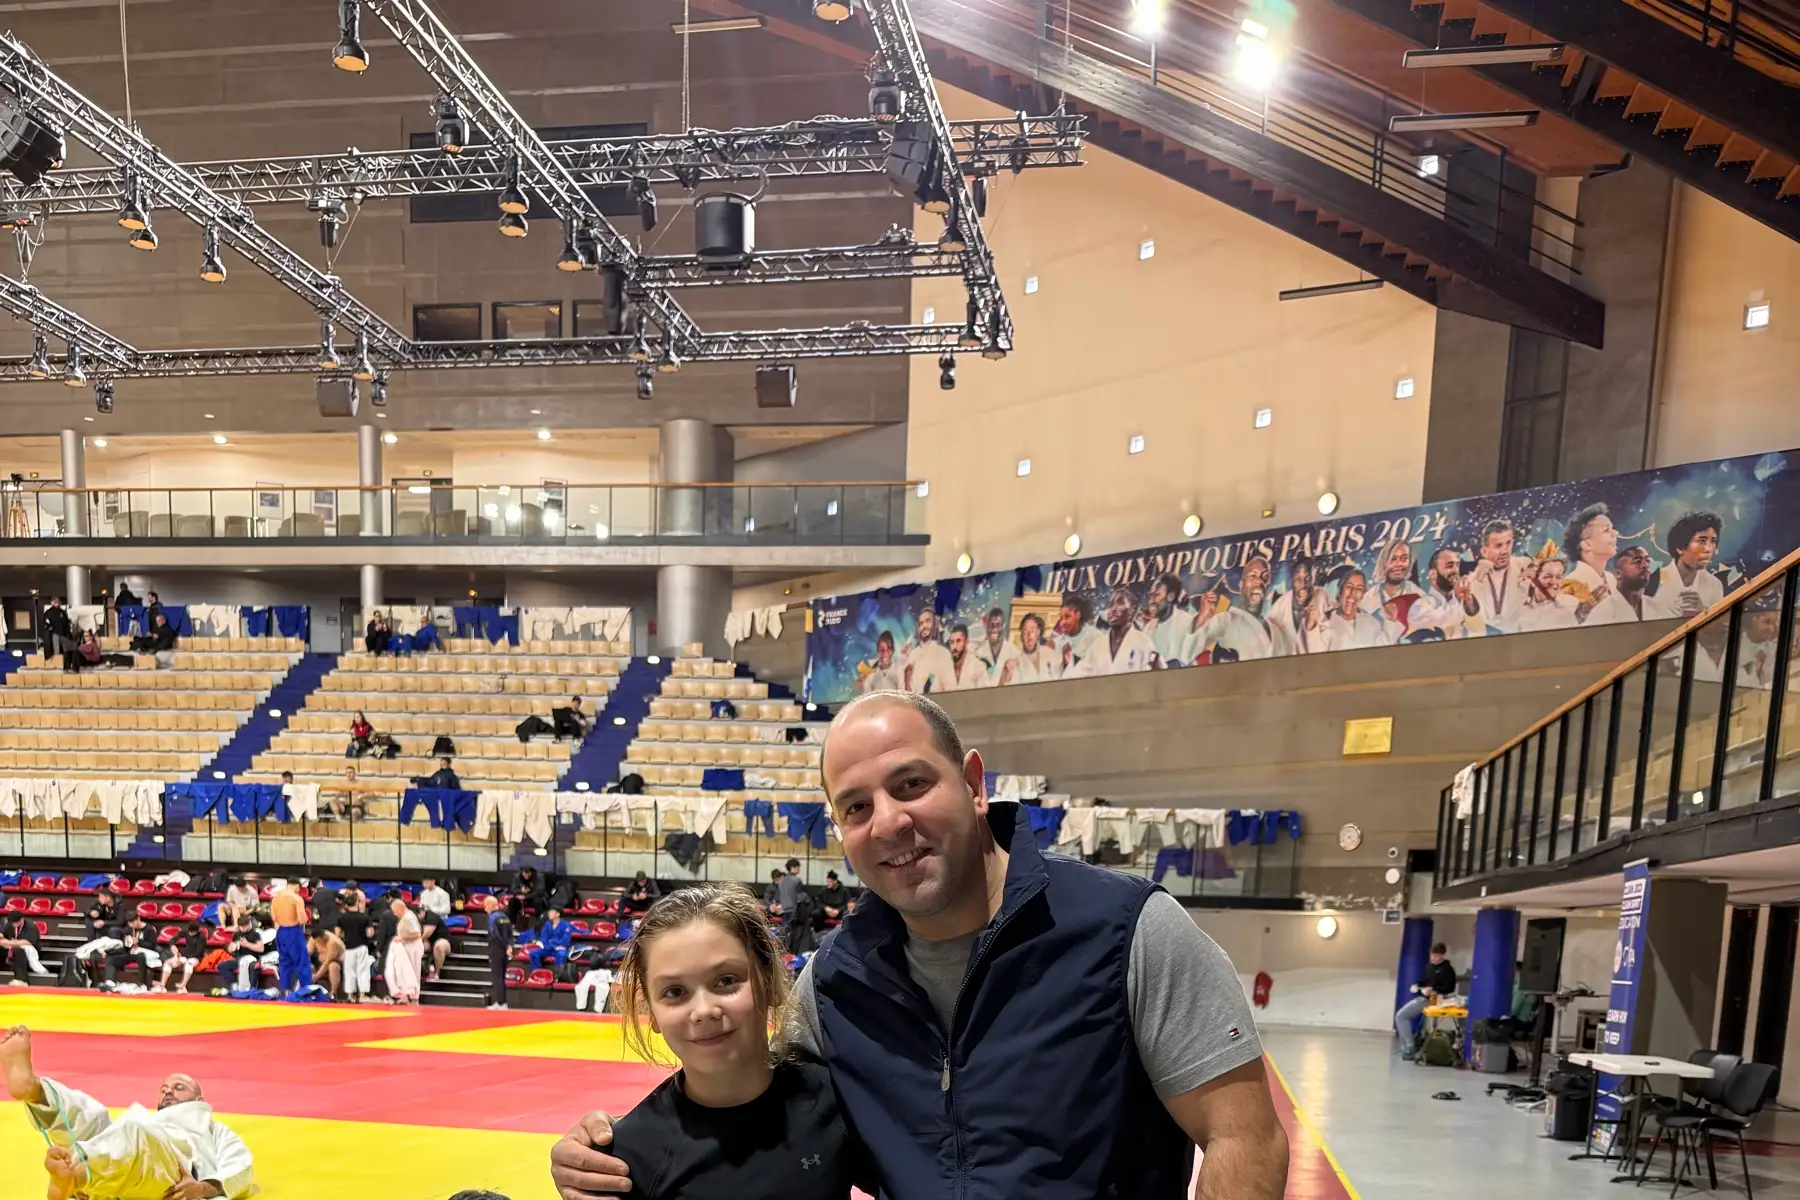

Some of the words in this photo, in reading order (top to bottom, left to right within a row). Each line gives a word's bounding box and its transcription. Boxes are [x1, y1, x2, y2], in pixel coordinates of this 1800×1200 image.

[1104, 537, 1275, 587] OLYMPIQUES
[1278, 524, 1366, 561] PARIS
[1370, 511, 1449, 550] 2024
[825, 609, 848, 618] FRANCE
